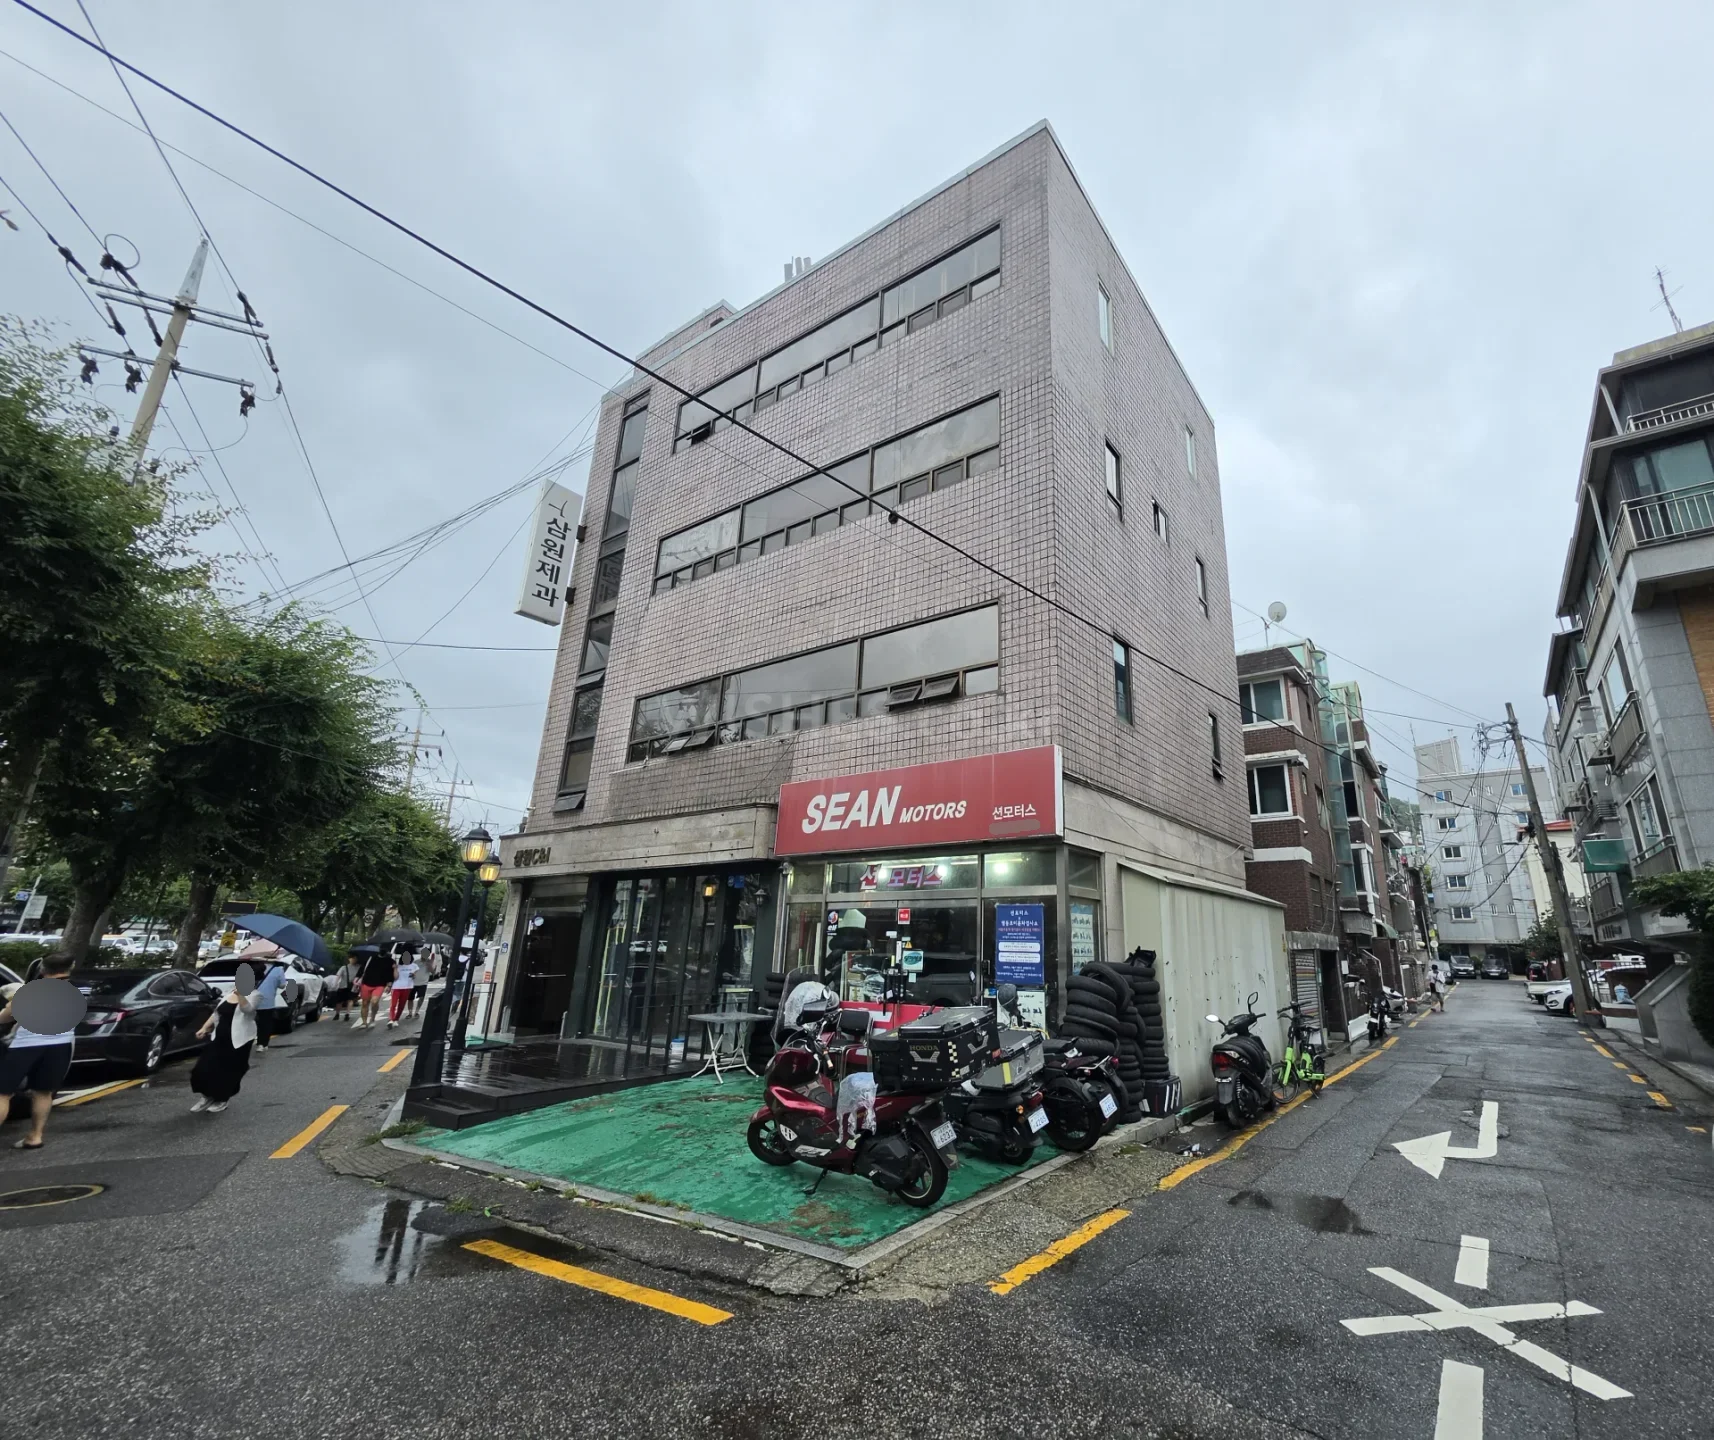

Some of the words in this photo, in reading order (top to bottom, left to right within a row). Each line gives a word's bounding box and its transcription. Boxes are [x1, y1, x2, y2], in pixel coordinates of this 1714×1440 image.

[532, 517, 572, 608] 삼원제과
[801, 785, 902, 834] SEAN
[899, 800, 967, 823] MOTORS
[992, 803, 1037, 820] 션모터스
